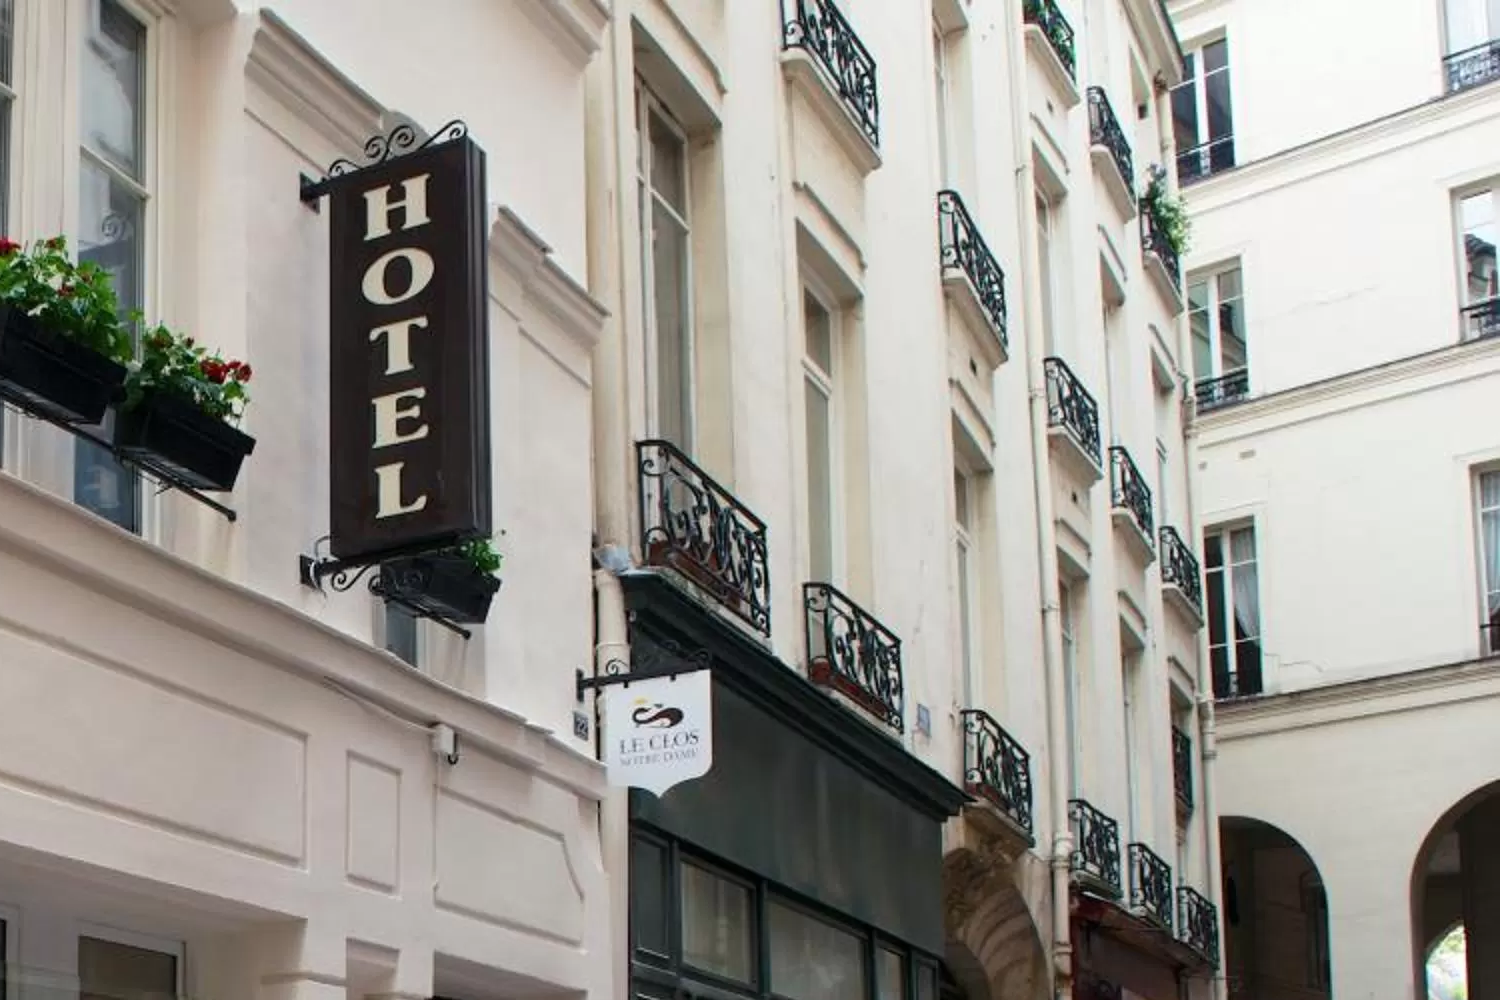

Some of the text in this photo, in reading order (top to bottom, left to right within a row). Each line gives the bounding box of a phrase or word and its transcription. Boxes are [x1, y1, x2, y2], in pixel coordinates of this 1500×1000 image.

[361, 172, 436, 521] HOTEL
[620, 730, 700, 754] LE CLOS
